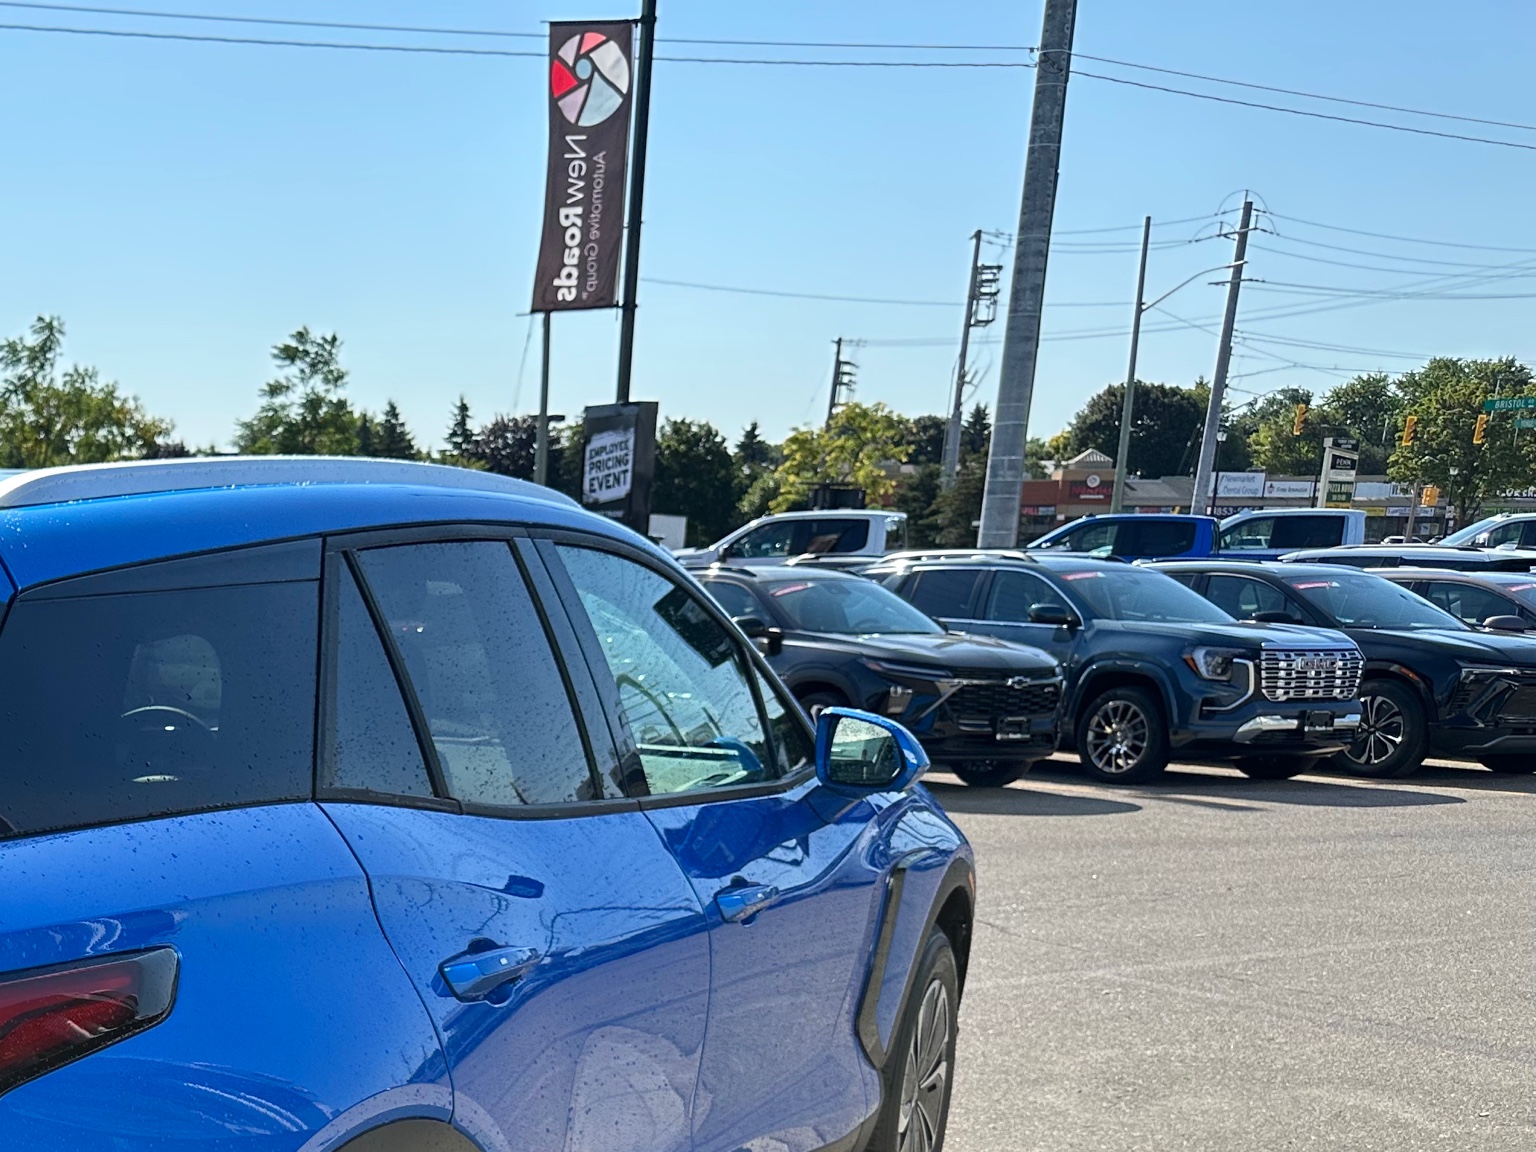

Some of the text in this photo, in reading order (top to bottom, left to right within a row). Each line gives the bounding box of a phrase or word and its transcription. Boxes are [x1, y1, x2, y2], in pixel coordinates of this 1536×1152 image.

[1494, 400, 1526, 409] BRISTOL
[588, 440, 630, 459] EMPLOYEE
[588, 453, 630, 476] PRICING
[588, 469, 630, 494] EVENT
